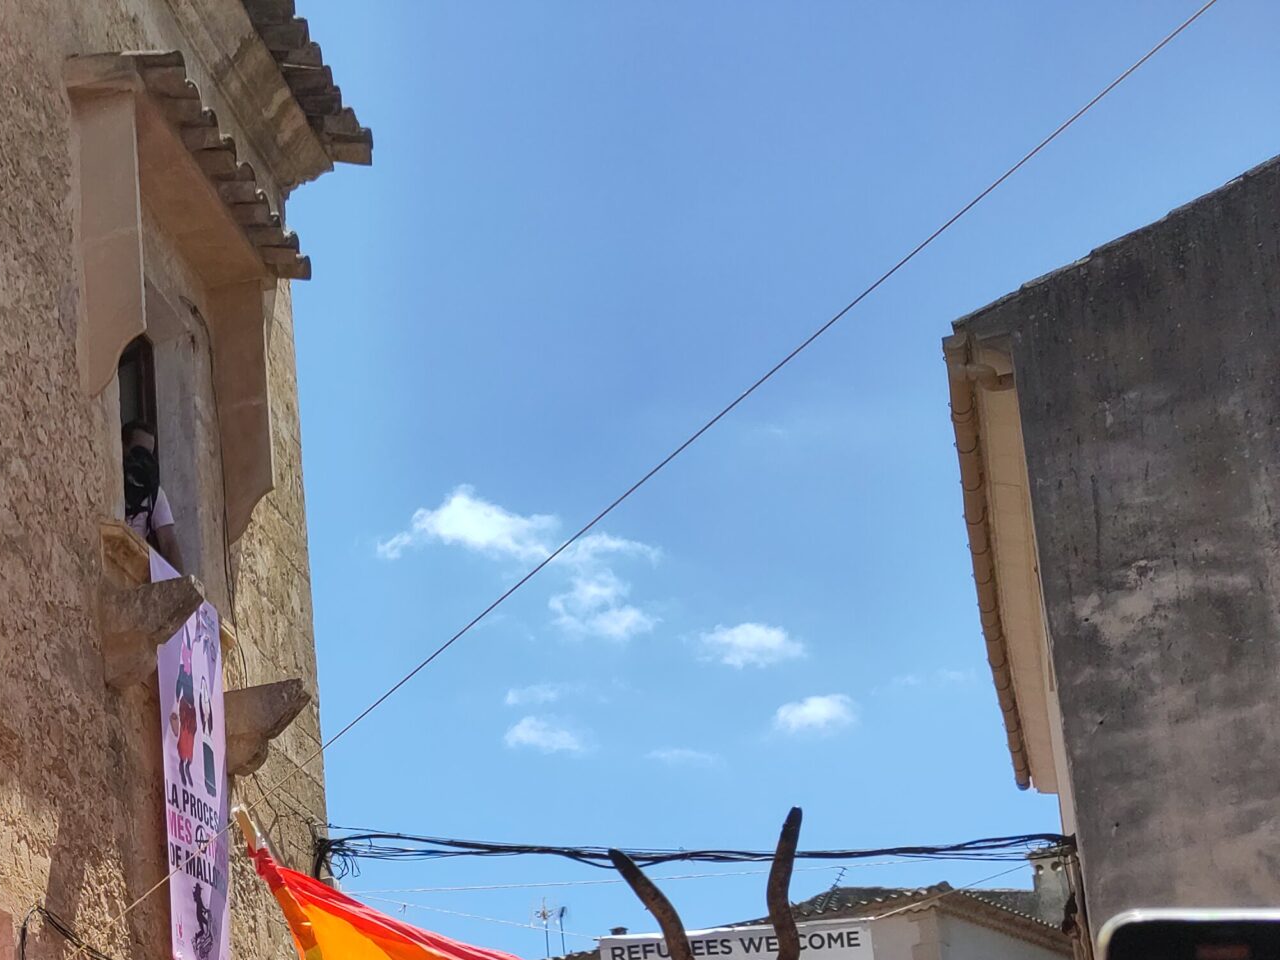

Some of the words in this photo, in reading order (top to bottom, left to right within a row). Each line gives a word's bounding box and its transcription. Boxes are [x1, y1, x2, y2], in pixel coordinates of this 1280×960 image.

[166, 779, 180, 809] LA
[170, 841, 183, 871] DE
[739, 931, 862, 955] WECOME
